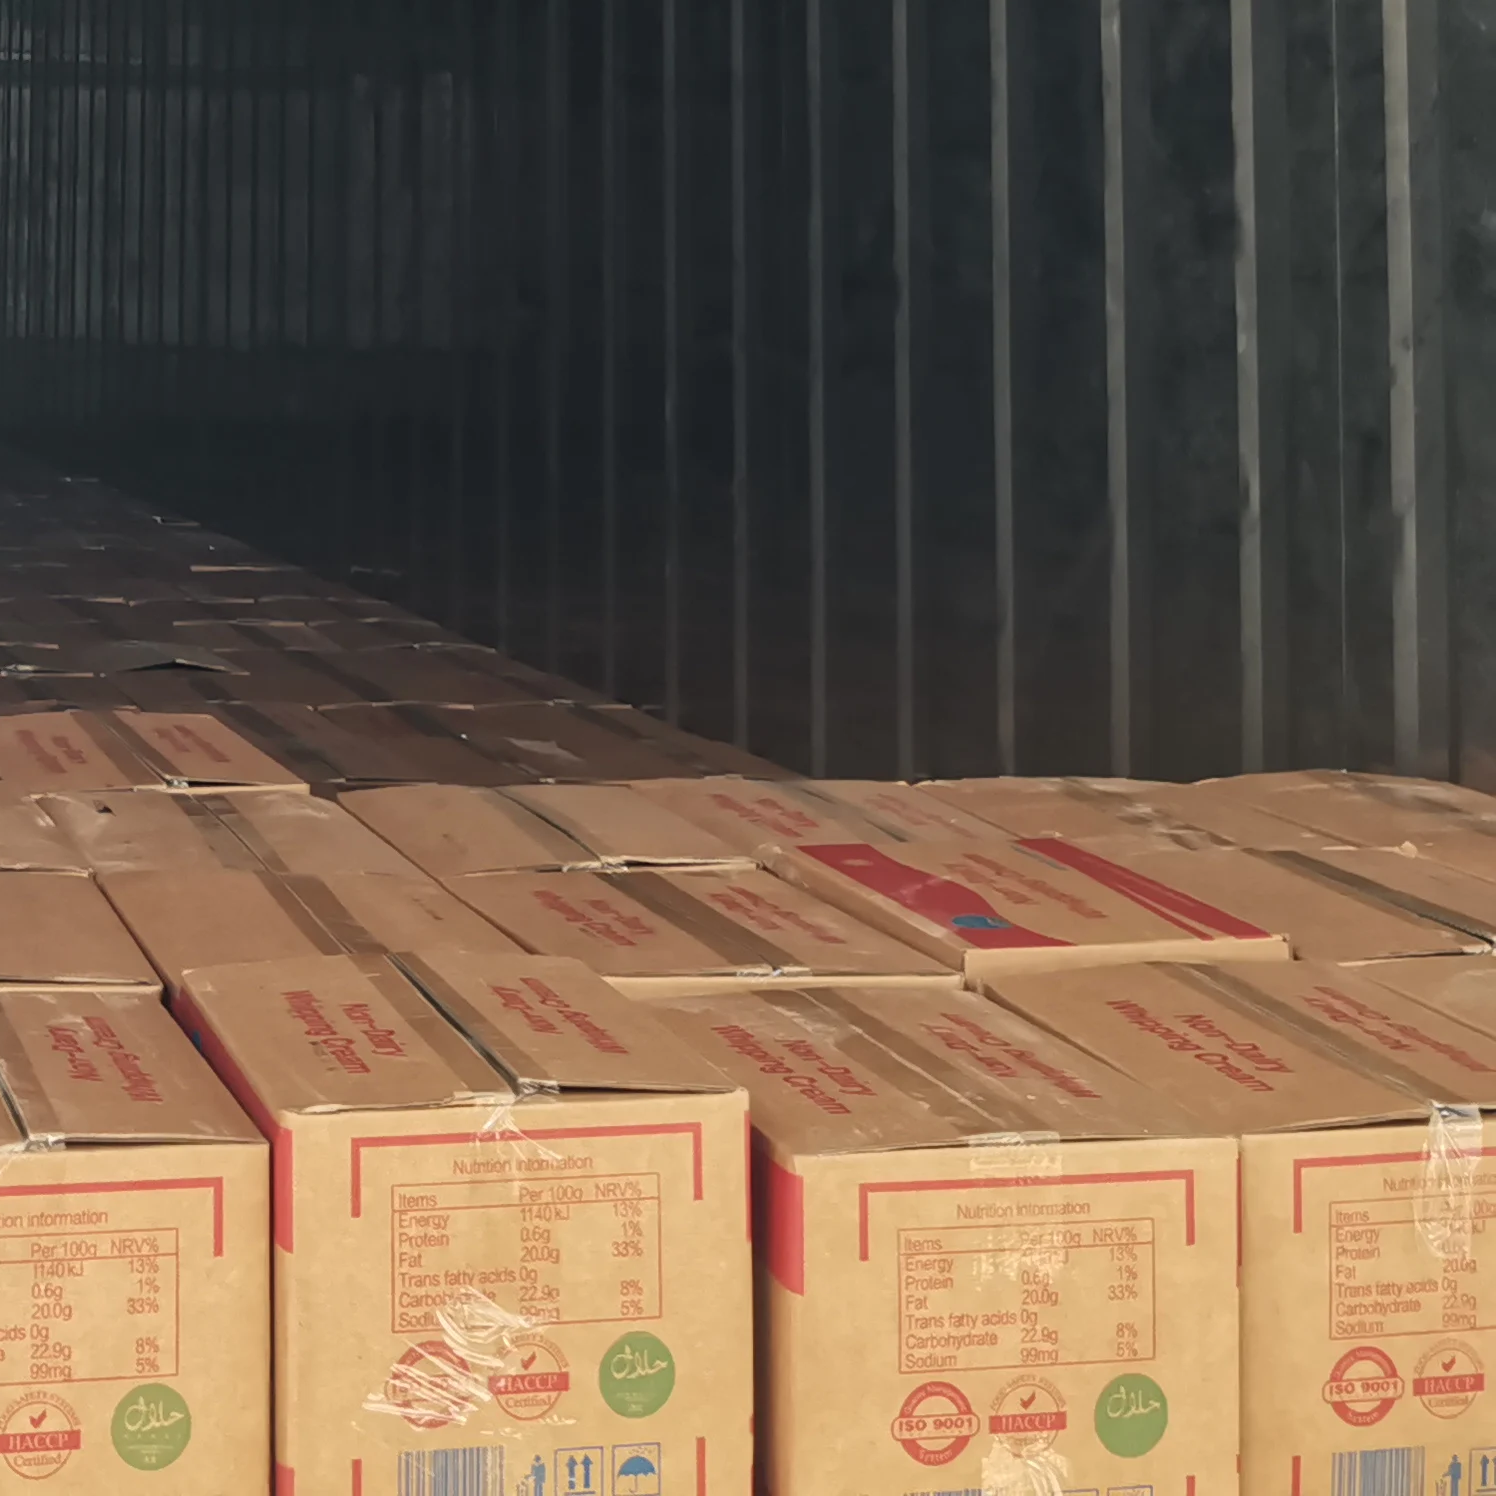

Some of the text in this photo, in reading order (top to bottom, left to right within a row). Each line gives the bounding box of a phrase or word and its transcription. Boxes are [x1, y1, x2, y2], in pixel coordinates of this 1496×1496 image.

[1172, 1014, 1296, 1073] Non-Dairy
[1194, 1052, 1276, 1092] Cream
[453, 1158, 512, 1175] Nutrition
[520, 1186, 583, 1202] Per 100g
[595, 1181, 642, 1197] NRV%
[399, 1192, 436, 1207] Items
[613, 1204, 643, 1216] 13%
[957, 1204, 1013, 1220] Nutrition
[1335, 1209, 1369, 1223] Items
[27, 1210, 109, 1228] information
[399, 1214, 448, 1230] Energy
[521, 1229, 550, 1244] 0.6g
[622, 1222, 643, 1237] 1%
[1093, 1227, 1137, 1242] NRV%
[1335, 1228, 1380, 1244] Energy
[111, 1239, 159, 1255] NRV%
[399, 1233, 449, 1248] Protein
[905, 1236, 942, 1251] Items
[31, 1241, 96, 1258] Per 100g
[520, 1246, 560, 1264] 20.0g
[612, 1242, 643, 1257] 33%
[1109, 1247, 1137, 1262] 13%
[1335, 1246, 1381, 1261] Protein
[129, 1258, 159, 1274] 13%
[399, 1253, 422, 1268] Fat
[905, 1257, 954, 1273] Energy
[399, 1268, 516, 1287] Trans fatty acids
[520, 1267, 537, 1284] 0g
[1118, 1266, 1137, 1280] 1%
[1335, 1265, 1356, 1280] Fat
[138, 1278, 160, 1293] 1%
[620, 1280, 643, 1295] 8%
[905, 1275, 953, 1290] Protein
[1335, 1279, 1439, 1298] Trans fatty acids
[1441, 1278, 1457, 1294] 0g
[32, 1284, 62, 1302] 0.6g
[1022, 1289, 1058, 1306] 20.0g
[1108, 1285, 1137, 1300] 33%
[127, 1298, 159, 1314] 33%
[621, 1300, 643, 1315] 5%
[906, 1296, 928, 1310] Fat
[1336, 1299, 1421, 1317] Carbohydrate
[32, 1304, 72, 1322] 20.0g
[905, 1309, 1016, 1330] Trans fatty acids
[1021, 1309, 1038, 1326] 0g
[30, 1324, 49, 1342] 0g
[1116, 1323, 1137, 1339] 8%
[1335, 1320, 1384, 1335] Sodium
[905, 1333, 997, 1349] Carbohydrate
[1021, 1329, 1058, 1346] 22.9g
[31, 1343, 71, 1361] 22.9g
[135, 1338, 158, 1354] 8%
[1117, 1342, 1137, 1358] 5%
[905, 1353, 957, 1368] Sodium
[1021, 1348, 1058, 1364] 99mg
[30, 1363, 71, 1380] 99mg
[136, 1357, 158, 1373] 5%
[1329, 1382, 1355, 1395] ISO
[899, 1418, 972, 1433] ISO 9001
[1001, 1414, 1055, 1430] HACCP
[8, 1433, 69, 1451] HACCP
